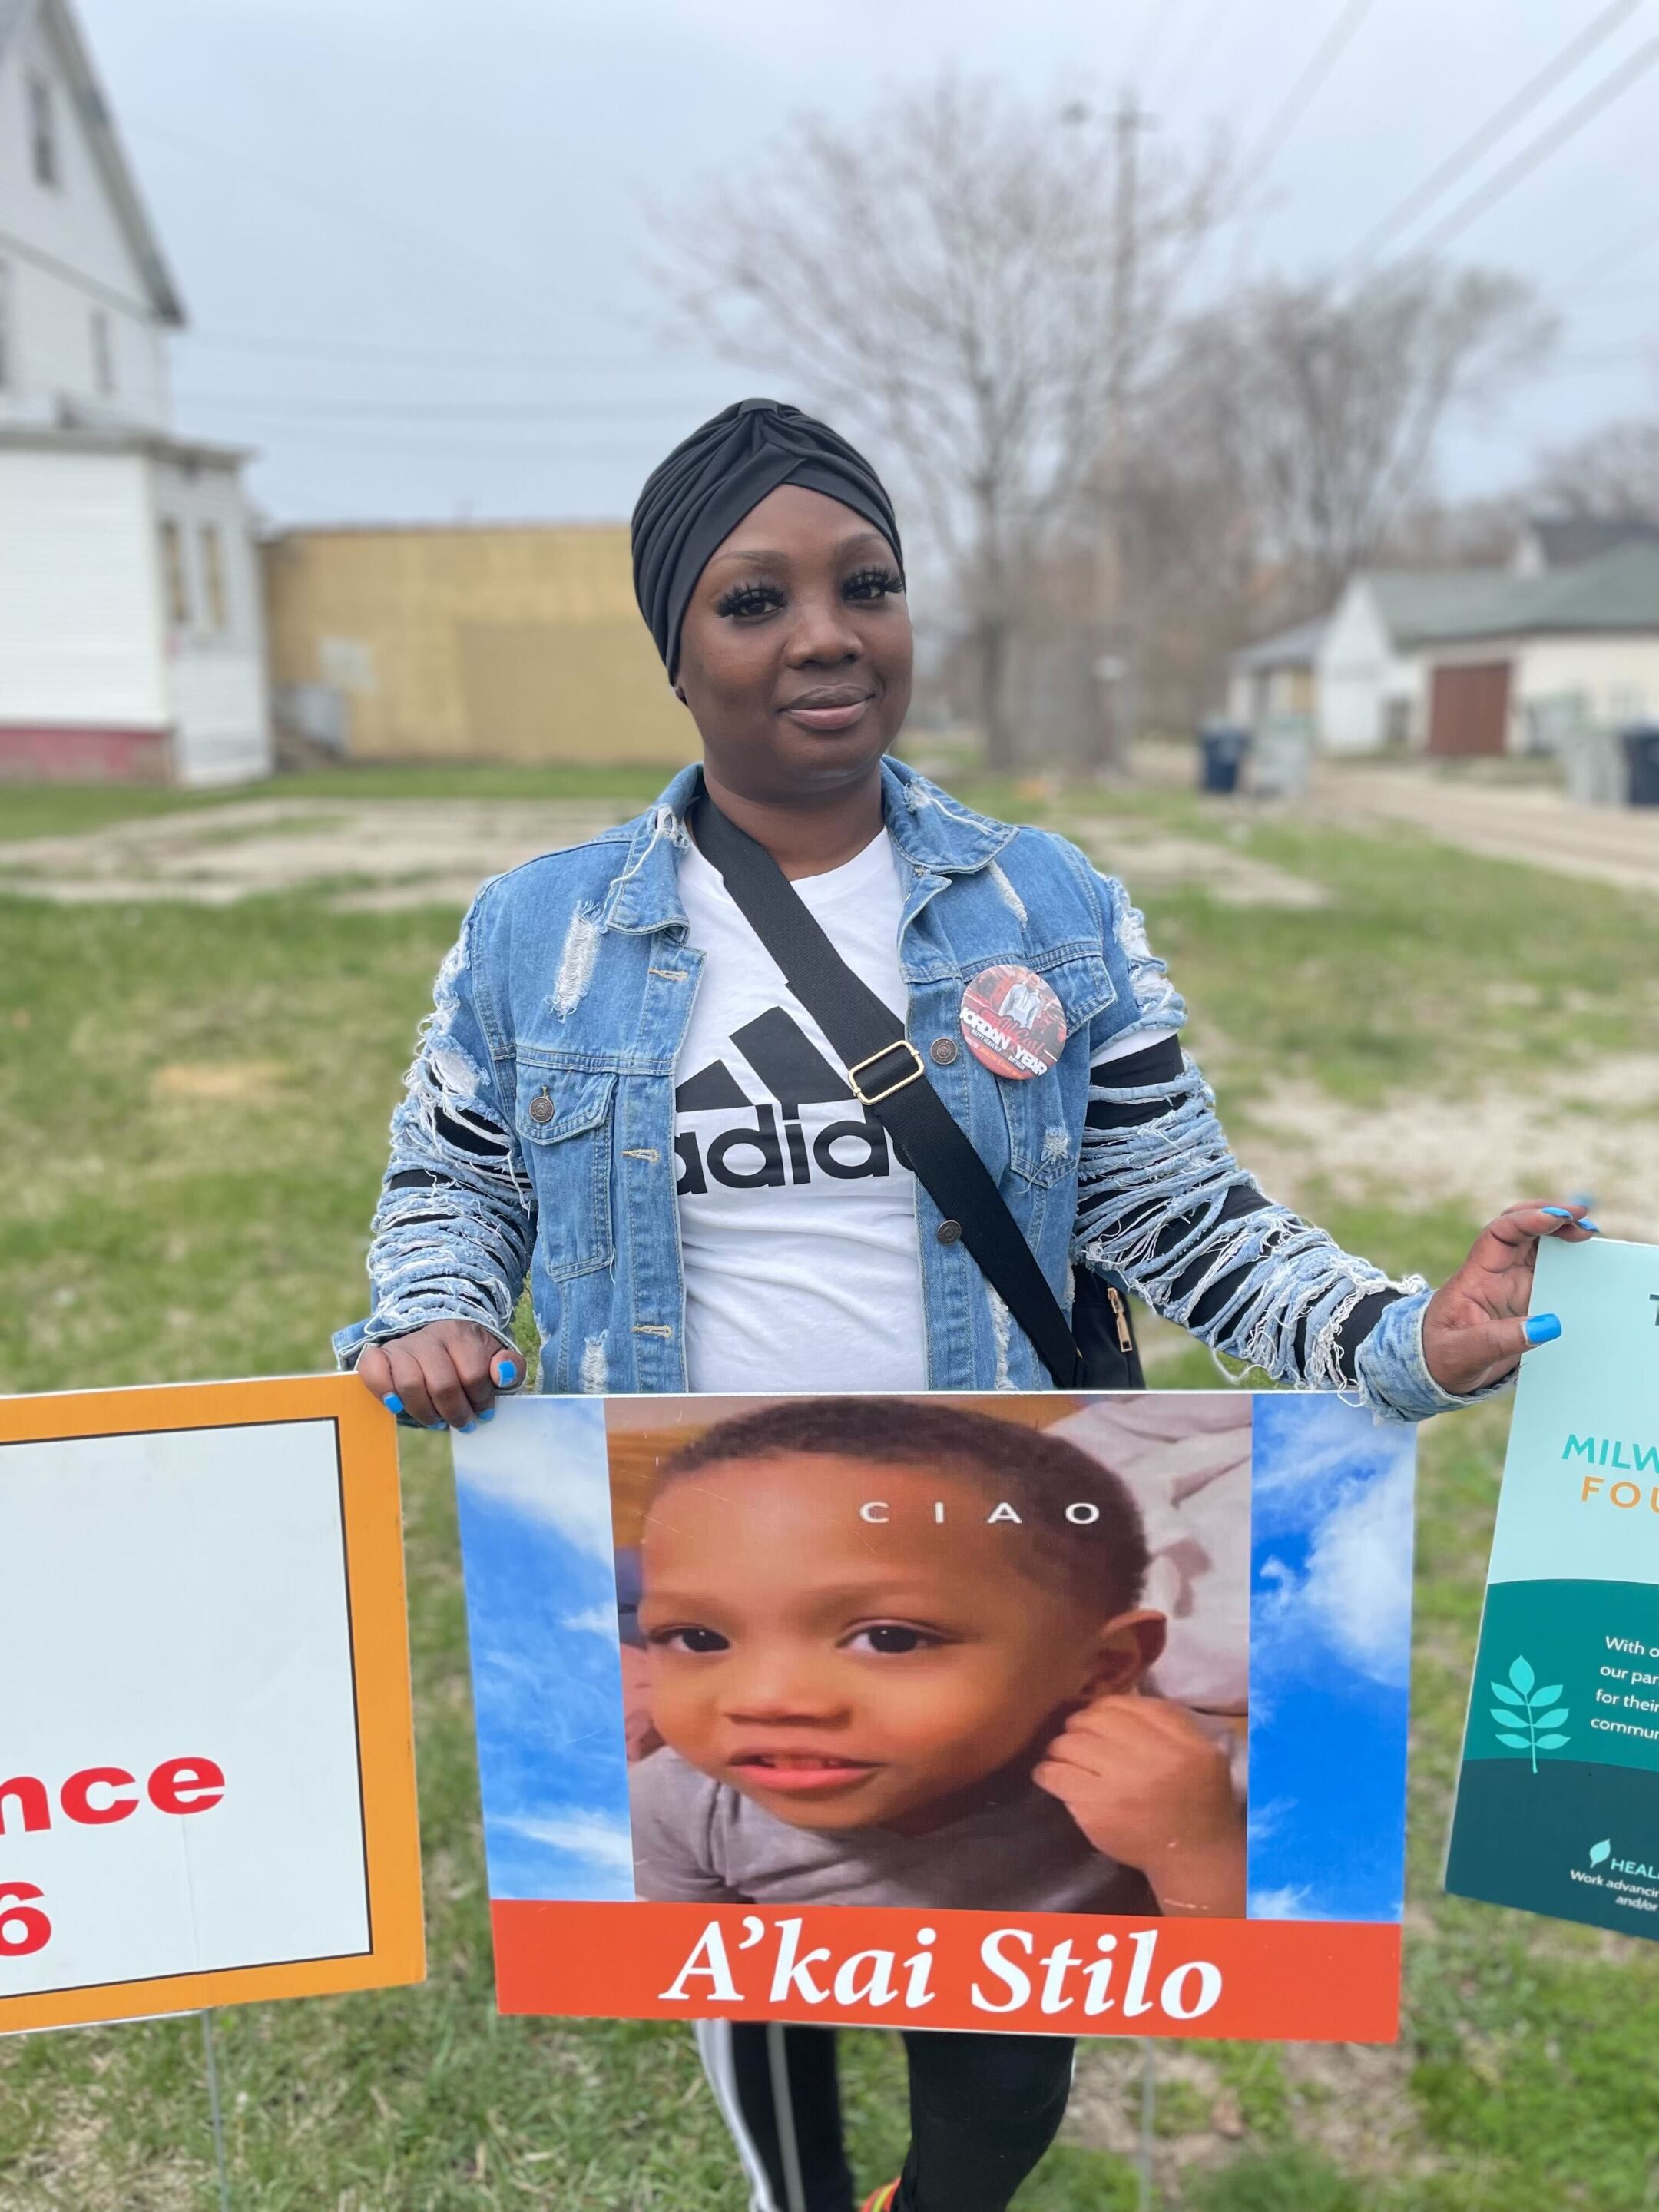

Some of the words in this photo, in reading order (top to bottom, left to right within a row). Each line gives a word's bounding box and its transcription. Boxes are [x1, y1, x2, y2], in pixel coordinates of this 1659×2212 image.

[1015, 1044, 1048, 1076] YEAR
[674, 1104, 915, 1194] adid
[859, 1502, 1101, 1525] CIAO
[1605, 1636, 1645, 1655] With
[1600, 1666, 1628, 1680] our
[1631, 1671, 1659, 1685] par
[1595, 1688, 1620, 1705] for
[0, 1757, 225, 1836] nce
[1570, 1869, 1604, 1886] Work
[1611, 1858, 1659, 1880] HEAL
[1615, 1896, 1658, 1912] and/or
[0, 1881, 51, 1957] 6
[658, 1916, 936, 2009] A'kai
[971, 1927, 1223, 2020] Stilo
